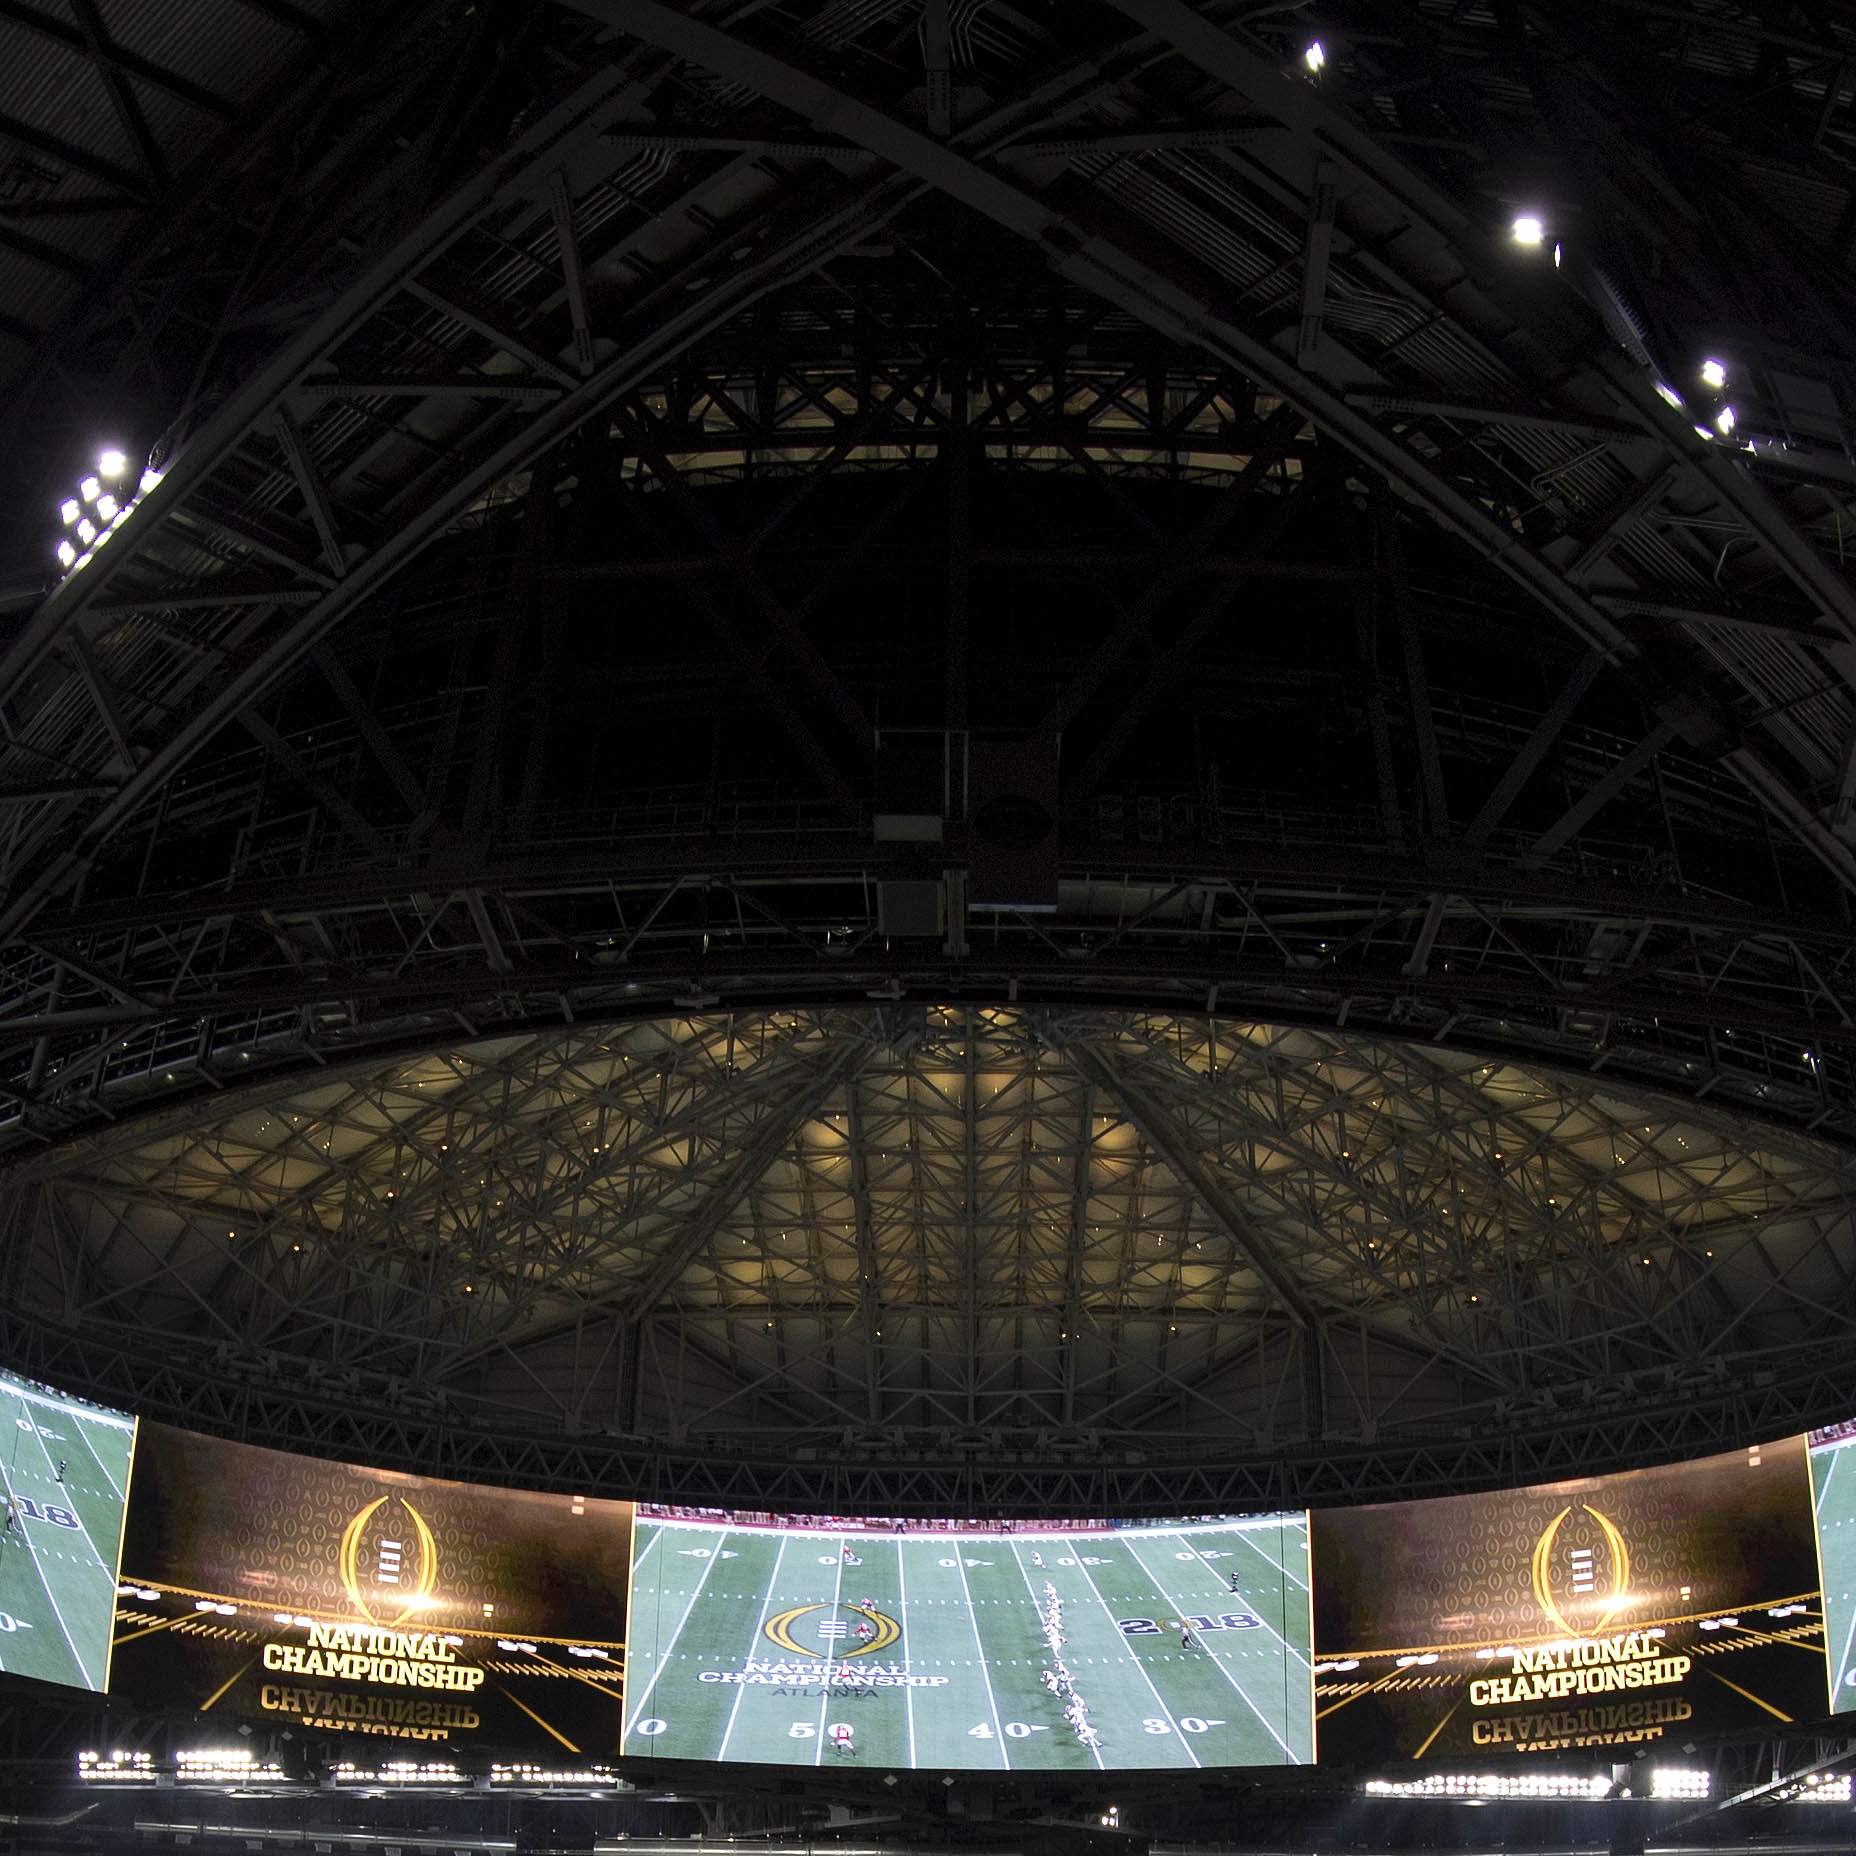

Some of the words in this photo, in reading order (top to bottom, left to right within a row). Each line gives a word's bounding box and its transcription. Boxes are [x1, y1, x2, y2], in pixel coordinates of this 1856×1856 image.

[307, 1622, 455, 1664] NATIONAL
[1511, 1632, 1661, 1674] NATIONAL
[263, 1643, 485, 1691] CHAMPIONSHIP
[744, 1662, 903, 1677] NATIONAL
[696, 1671, 949, 1688] CHAMPIONSHIP
[1469, 1656, 1691, 1706] CHAMPIONSHIP
[769, 1687, 879, 1699] ATLANTA
[968, 1722, 1031, 1739] 40
[1143, 1718, 1206, 1734] 30
